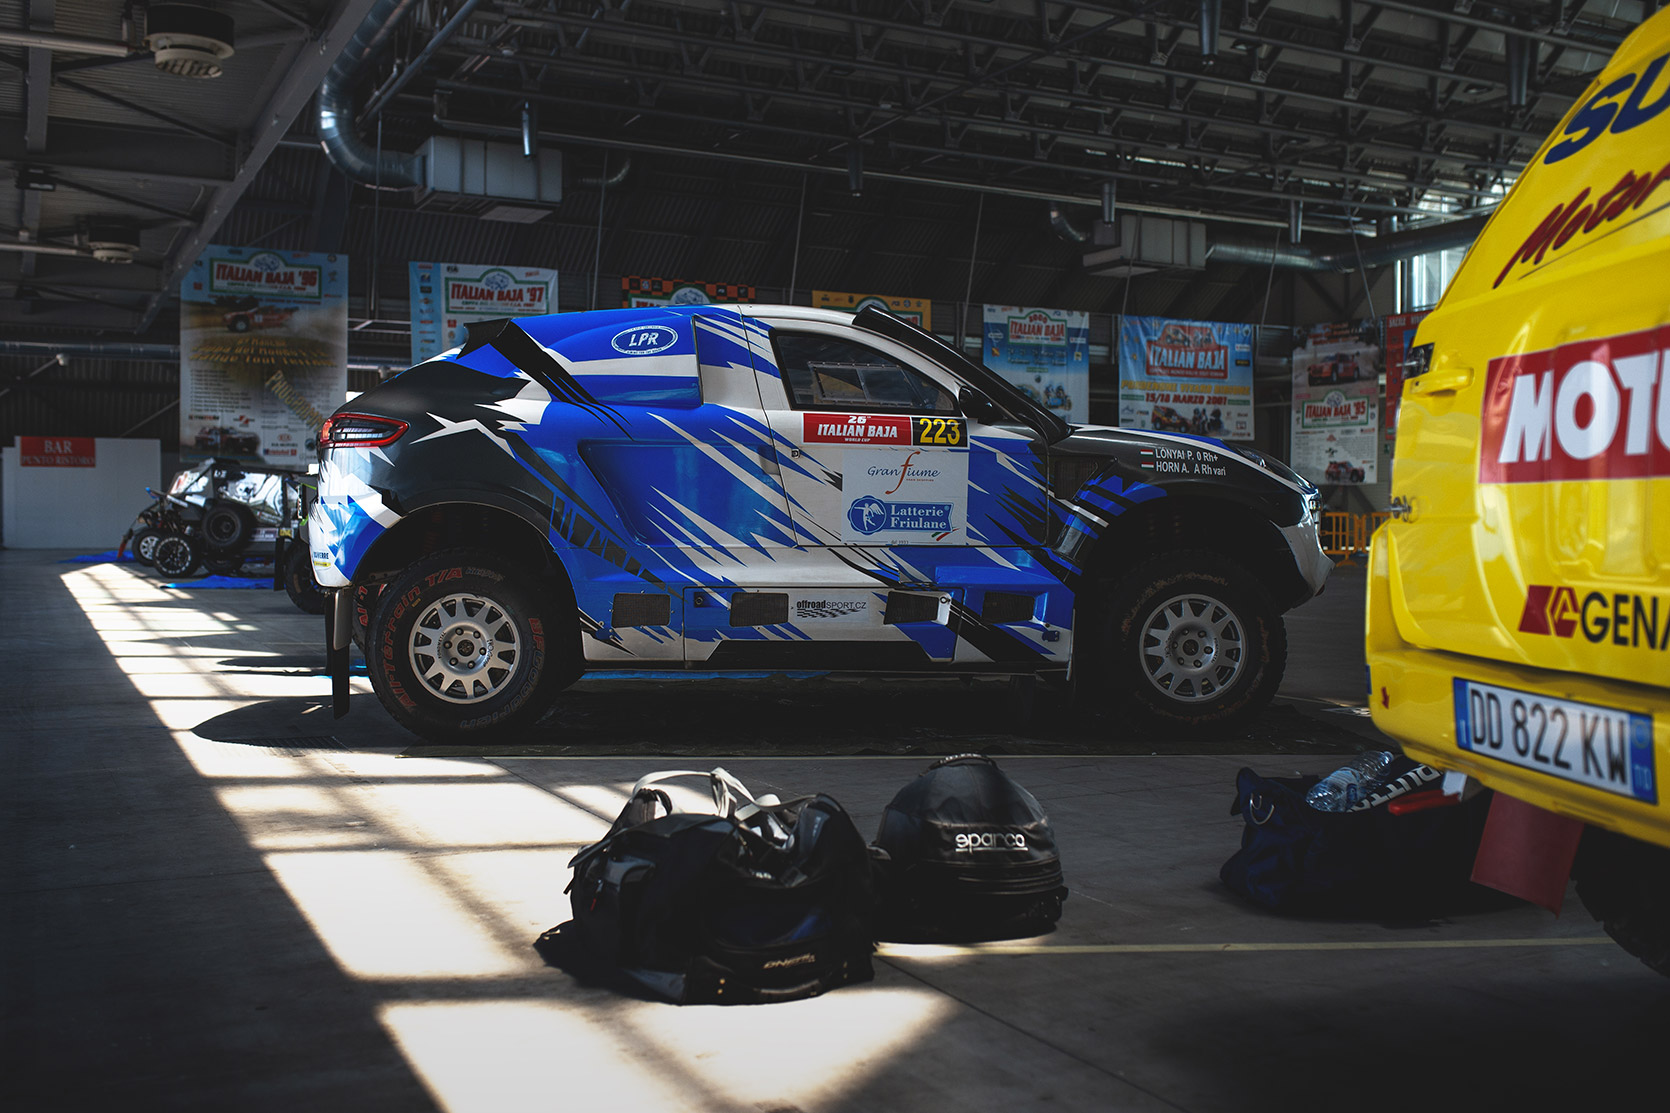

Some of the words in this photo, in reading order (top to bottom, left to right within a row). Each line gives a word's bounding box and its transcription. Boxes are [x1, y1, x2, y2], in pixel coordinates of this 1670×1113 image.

[216, 263, 262, 283] ITALIAN
[265, 271, 295, 285] BAJA
[451, 284, 494, 300] ITALIAN
[497, 290, 524, 302] BAJA
[527, 287, 544, 303] '97
[1010, 321, 1042, 336] ITALIAN
[1044, 324, 1065, 337] BAJA
[629, 332, 659, 347] LPR
[1149, 345, 1195, 369] ITALIAN
[1197, 349, 1225, 370] BAJA
[1172, 394, 1205, 405] MARZO
[1206, 396, 1228, 405] 2001
[1305, 404, 1331, 418] ITALIAN
[1334, 403, 1351, 416] BAJA
[817, 424, 865, 437] ITALIAN
[867, 425, 898, 438] BAJA
[919, 417, 960, 445] 223
[44, 440, 73, 455] BAR
[22, 455, 53, 465] PUNTO
[55, 455, 95, 465] RISTORO
[1187, 450, 1195, 460] P.
[1203, 451, 1218, 462] Rh+
[1156, 461, 1180, 473] HORN
[1181, 463, 1190, 473] A.
[1194, 463, 1201, 474] A
[1202, 464, 1212, 475] Rh
[890, 504, 944, 517] Latterie
[890, 517, 947, 529] Friulane
[425, 567, 463, 587] T/A
[383, 585, 421, 712] All-Terrain
[459, 618, 545, 729] BFGoodrich
[1470, 688, 1503, 750] DD
[1512, 699, 1572, 771] 822
[1581, 711, 1627, 785] KW
[955, 833, 1027, 855] sparco
